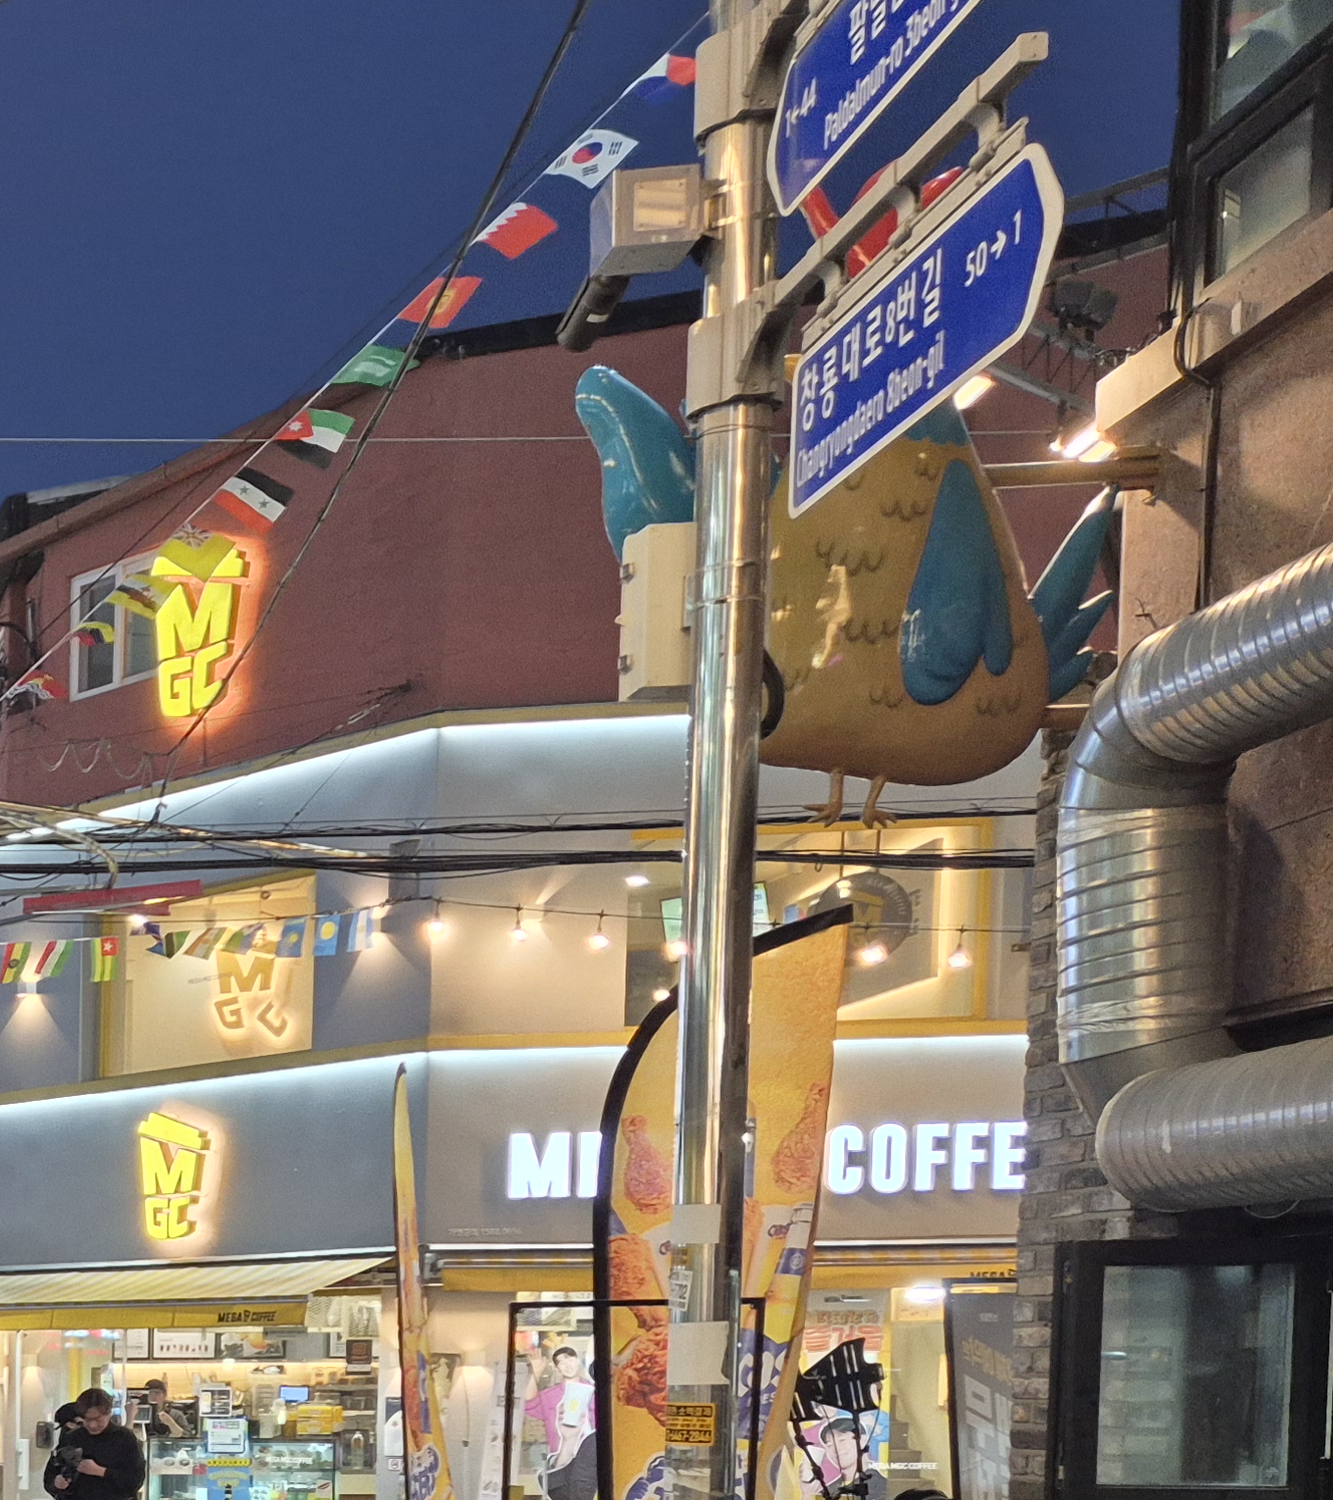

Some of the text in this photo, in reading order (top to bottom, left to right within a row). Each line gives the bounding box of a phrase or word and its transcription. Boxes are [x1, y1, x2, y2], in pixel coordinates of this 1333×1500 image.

[964, 209, 1022, 287] 50 1
[800, 248, 942, 431] 창룡대로8번길
[886, 329, 946, 414] 8beon-gil
[144, 1196, 193, 1240] GC
[217, 1310, 278, 1324] MEGA COFFEE
[908, 1461, 938, 1470] COFFEE
